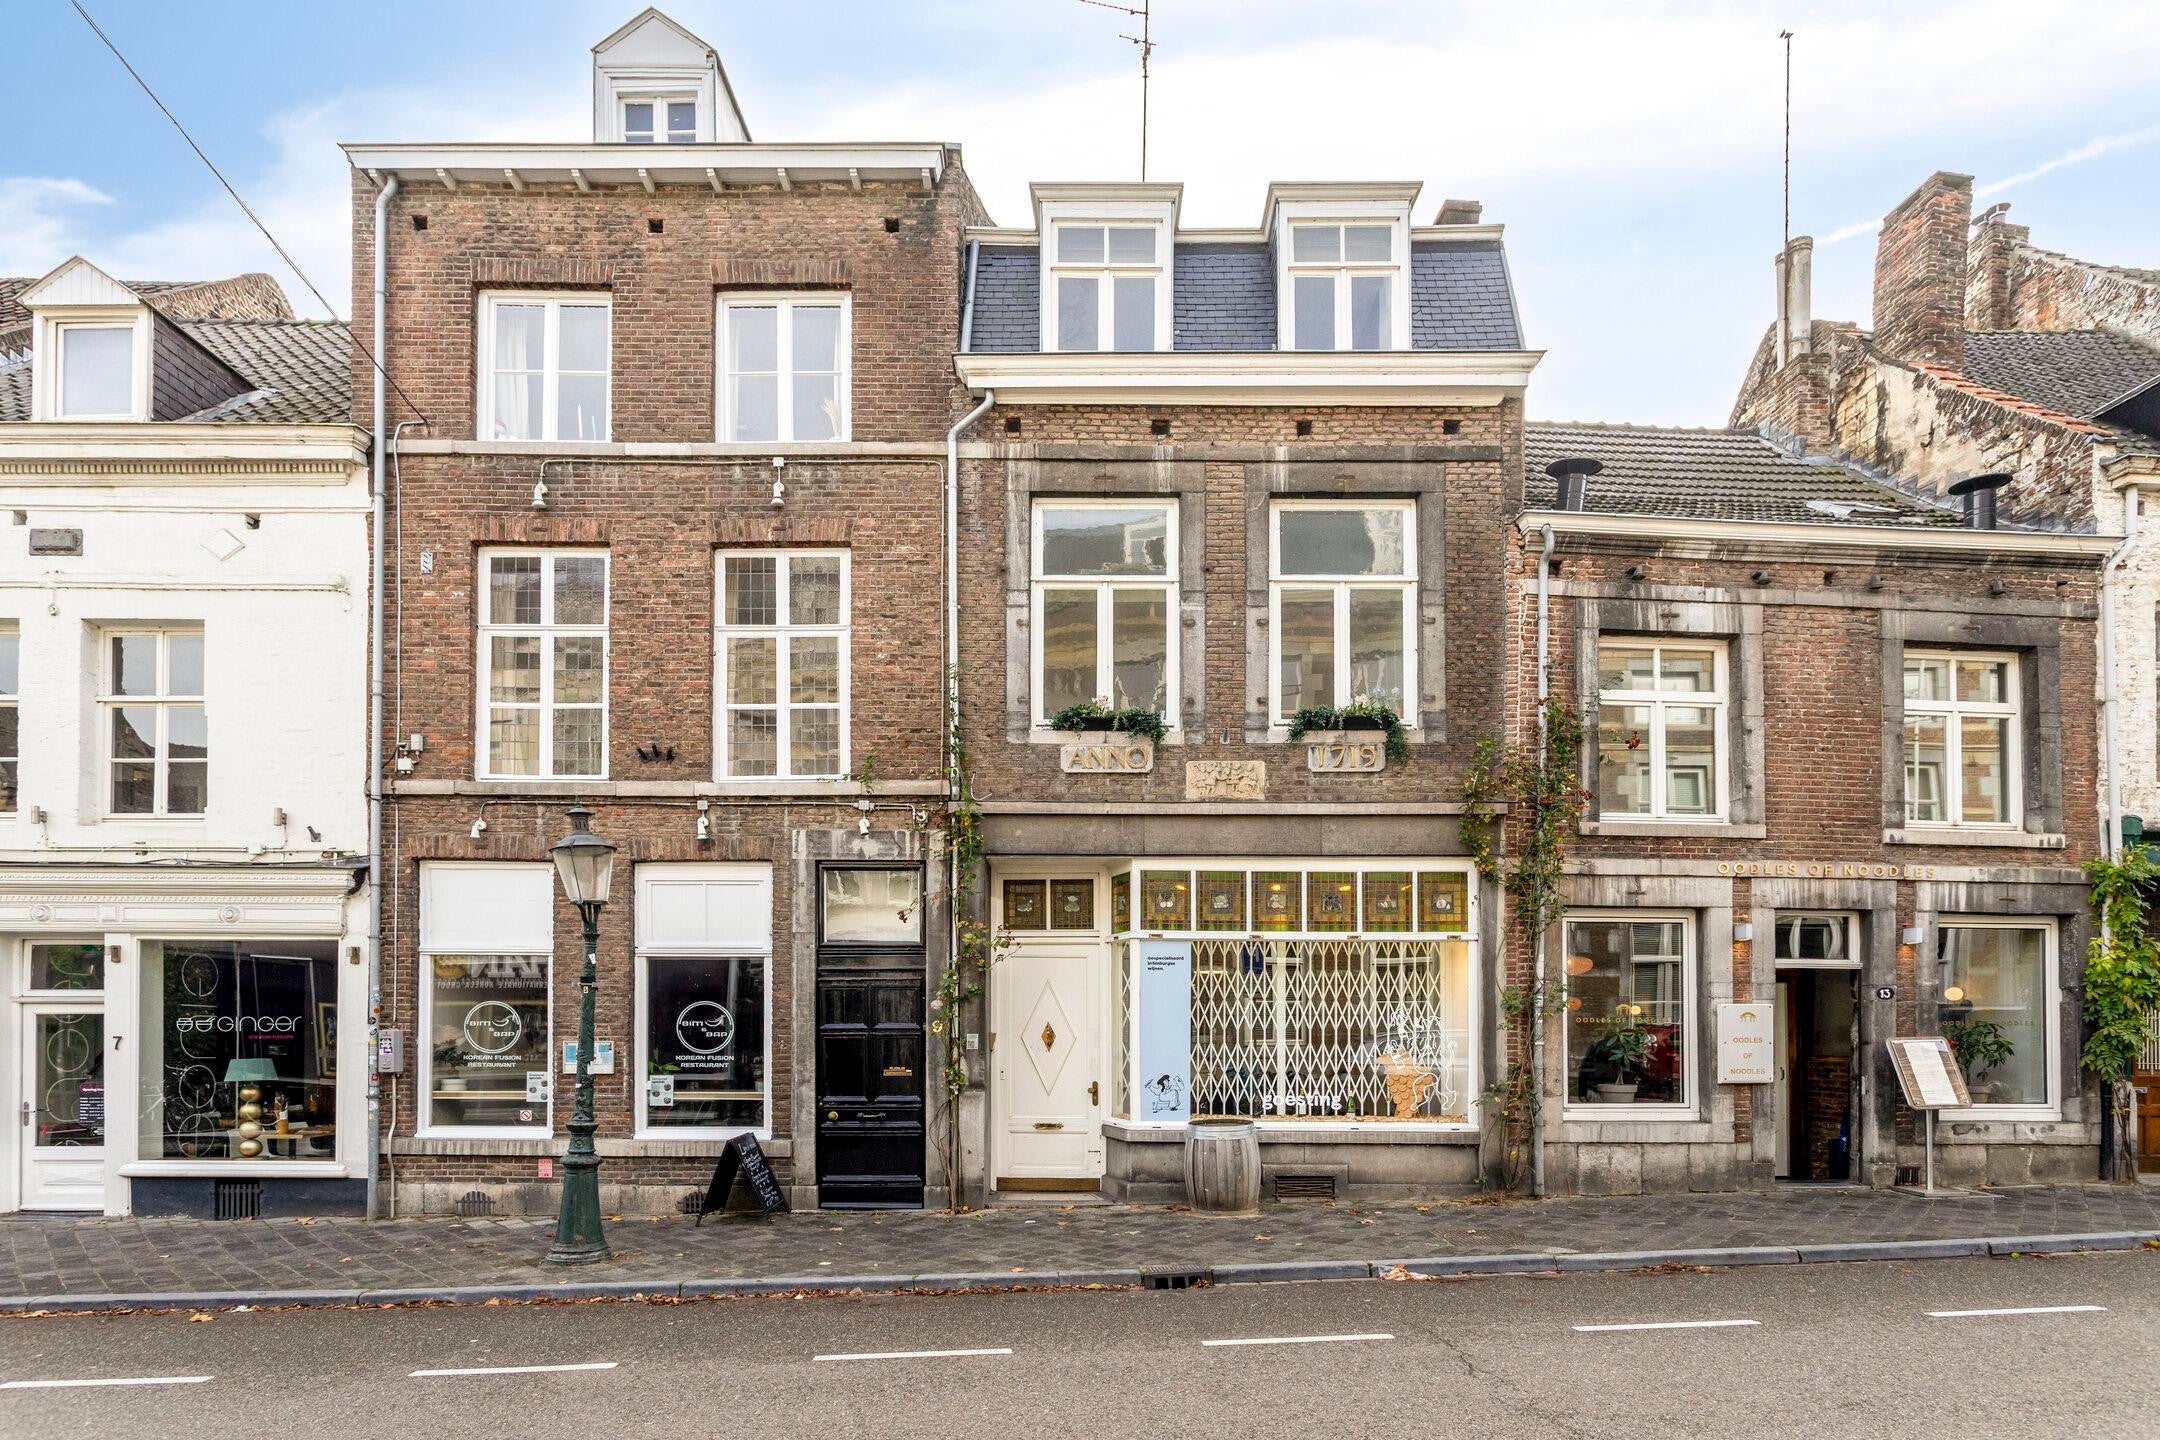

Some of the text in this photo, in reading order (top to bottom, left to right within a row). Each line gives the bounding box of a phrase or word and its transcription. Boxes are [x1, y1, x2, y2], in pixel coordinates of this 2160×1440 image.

[1067, 745, 1149, 769] ANNO
[1317, 744, 1377, 768] 1719
[1717, 863, 1936, 878] OODLES OF NOODLES
[1880, 989, 1890, 999] 13
[112, 1035, 123, 1050] 7
[1261, 1092, 1342, 1110] goesting
